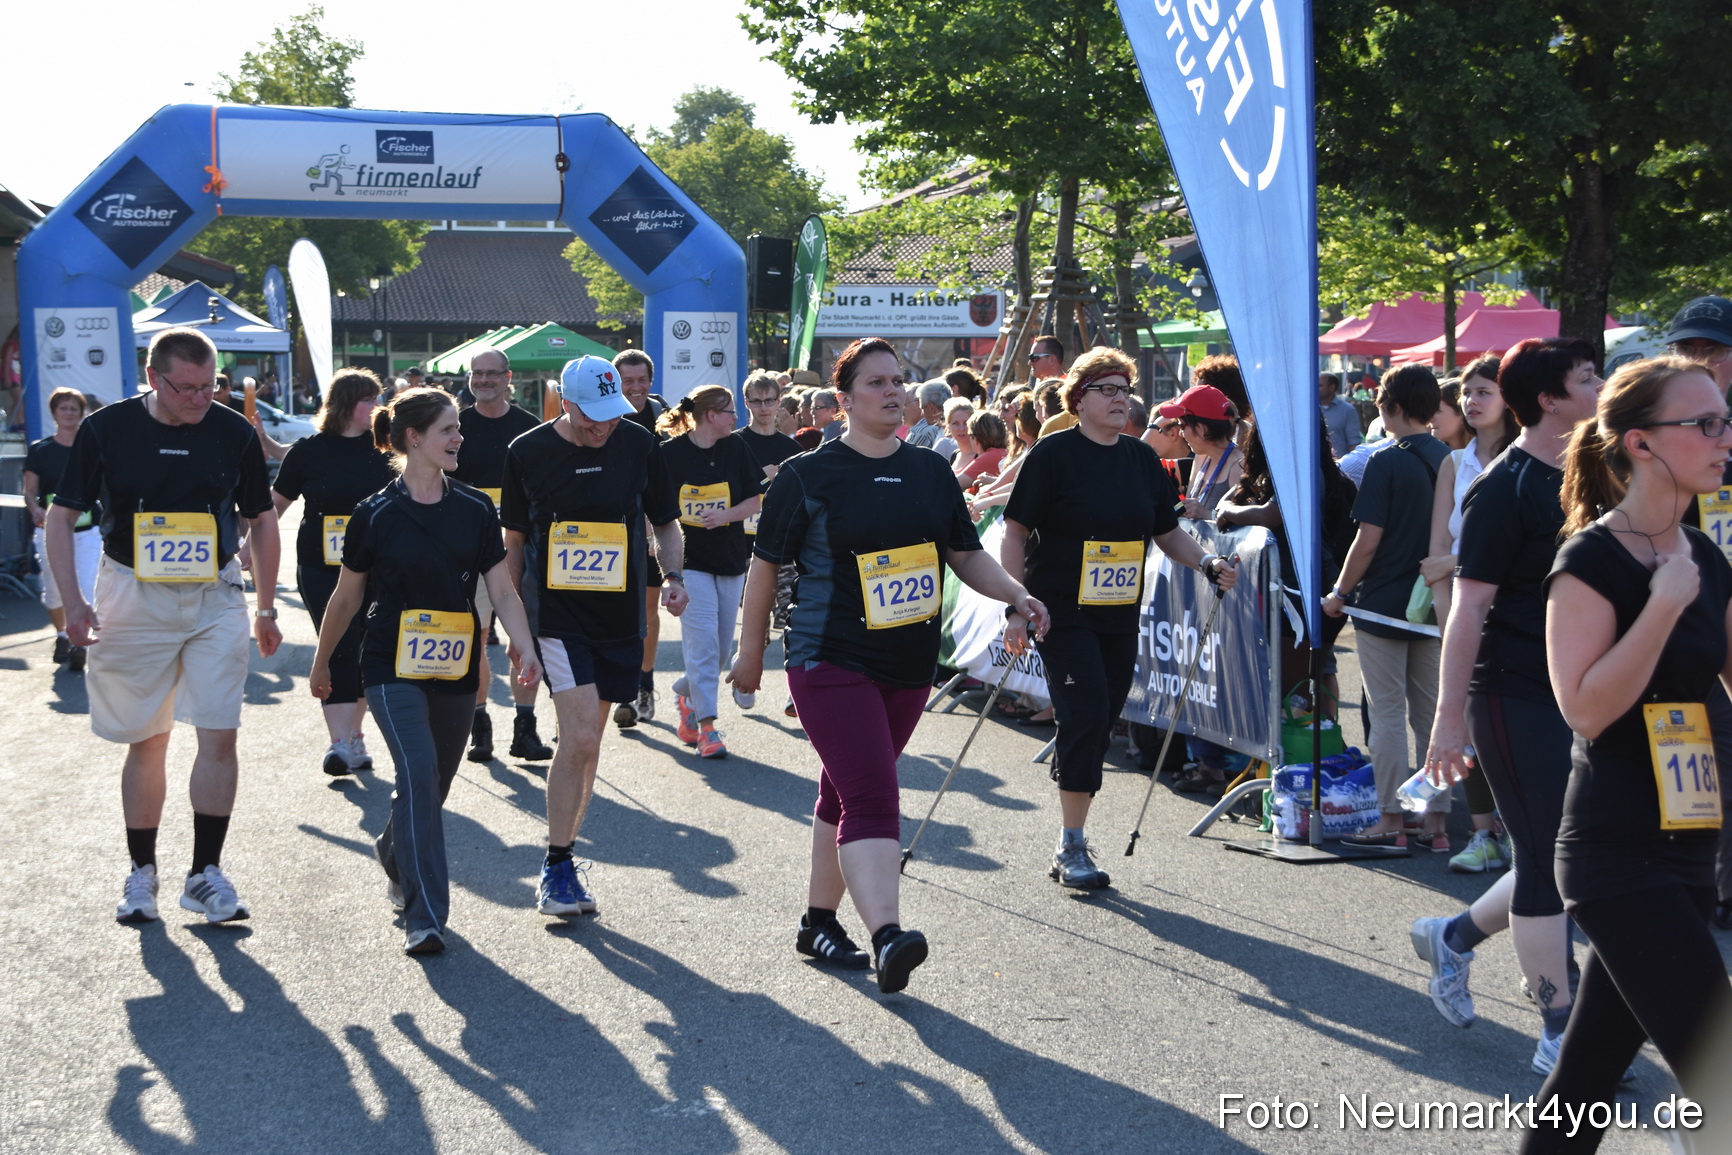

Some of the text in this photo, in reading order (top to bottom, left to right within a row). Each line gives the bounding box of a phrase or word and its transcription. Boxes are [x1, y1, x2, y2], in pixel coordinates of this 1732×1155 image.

[389, 143, 431, 152] Fischer
[355, 164, 482, 188] firmenlauf
[356, 188, 408, 197] neumarkt
[105, 204, 178, 220] Fischer
[612, 212, 631, 222] und
[632, 209, 649, 220] das
[113, 219, 171, 227] AUTOMOBILE
[662, 219, 683, 229] mit!
[892, 322, 932, 330] angenehmen
[910, 314, 927, 323] grüßt
[597, 382, 618, 397] NY
[144, 540, 210, 563] 1225
[557, 549, 619, 572] 1227
[1089, 567, 1138, 588] 1262
[872, 574, 935, 607] 1229
[1137, 604, 1221, 673] Fischer
[407, 637, 465, 661] 1230
[1147, 670, 1217, 708] AUTOMOBILE
